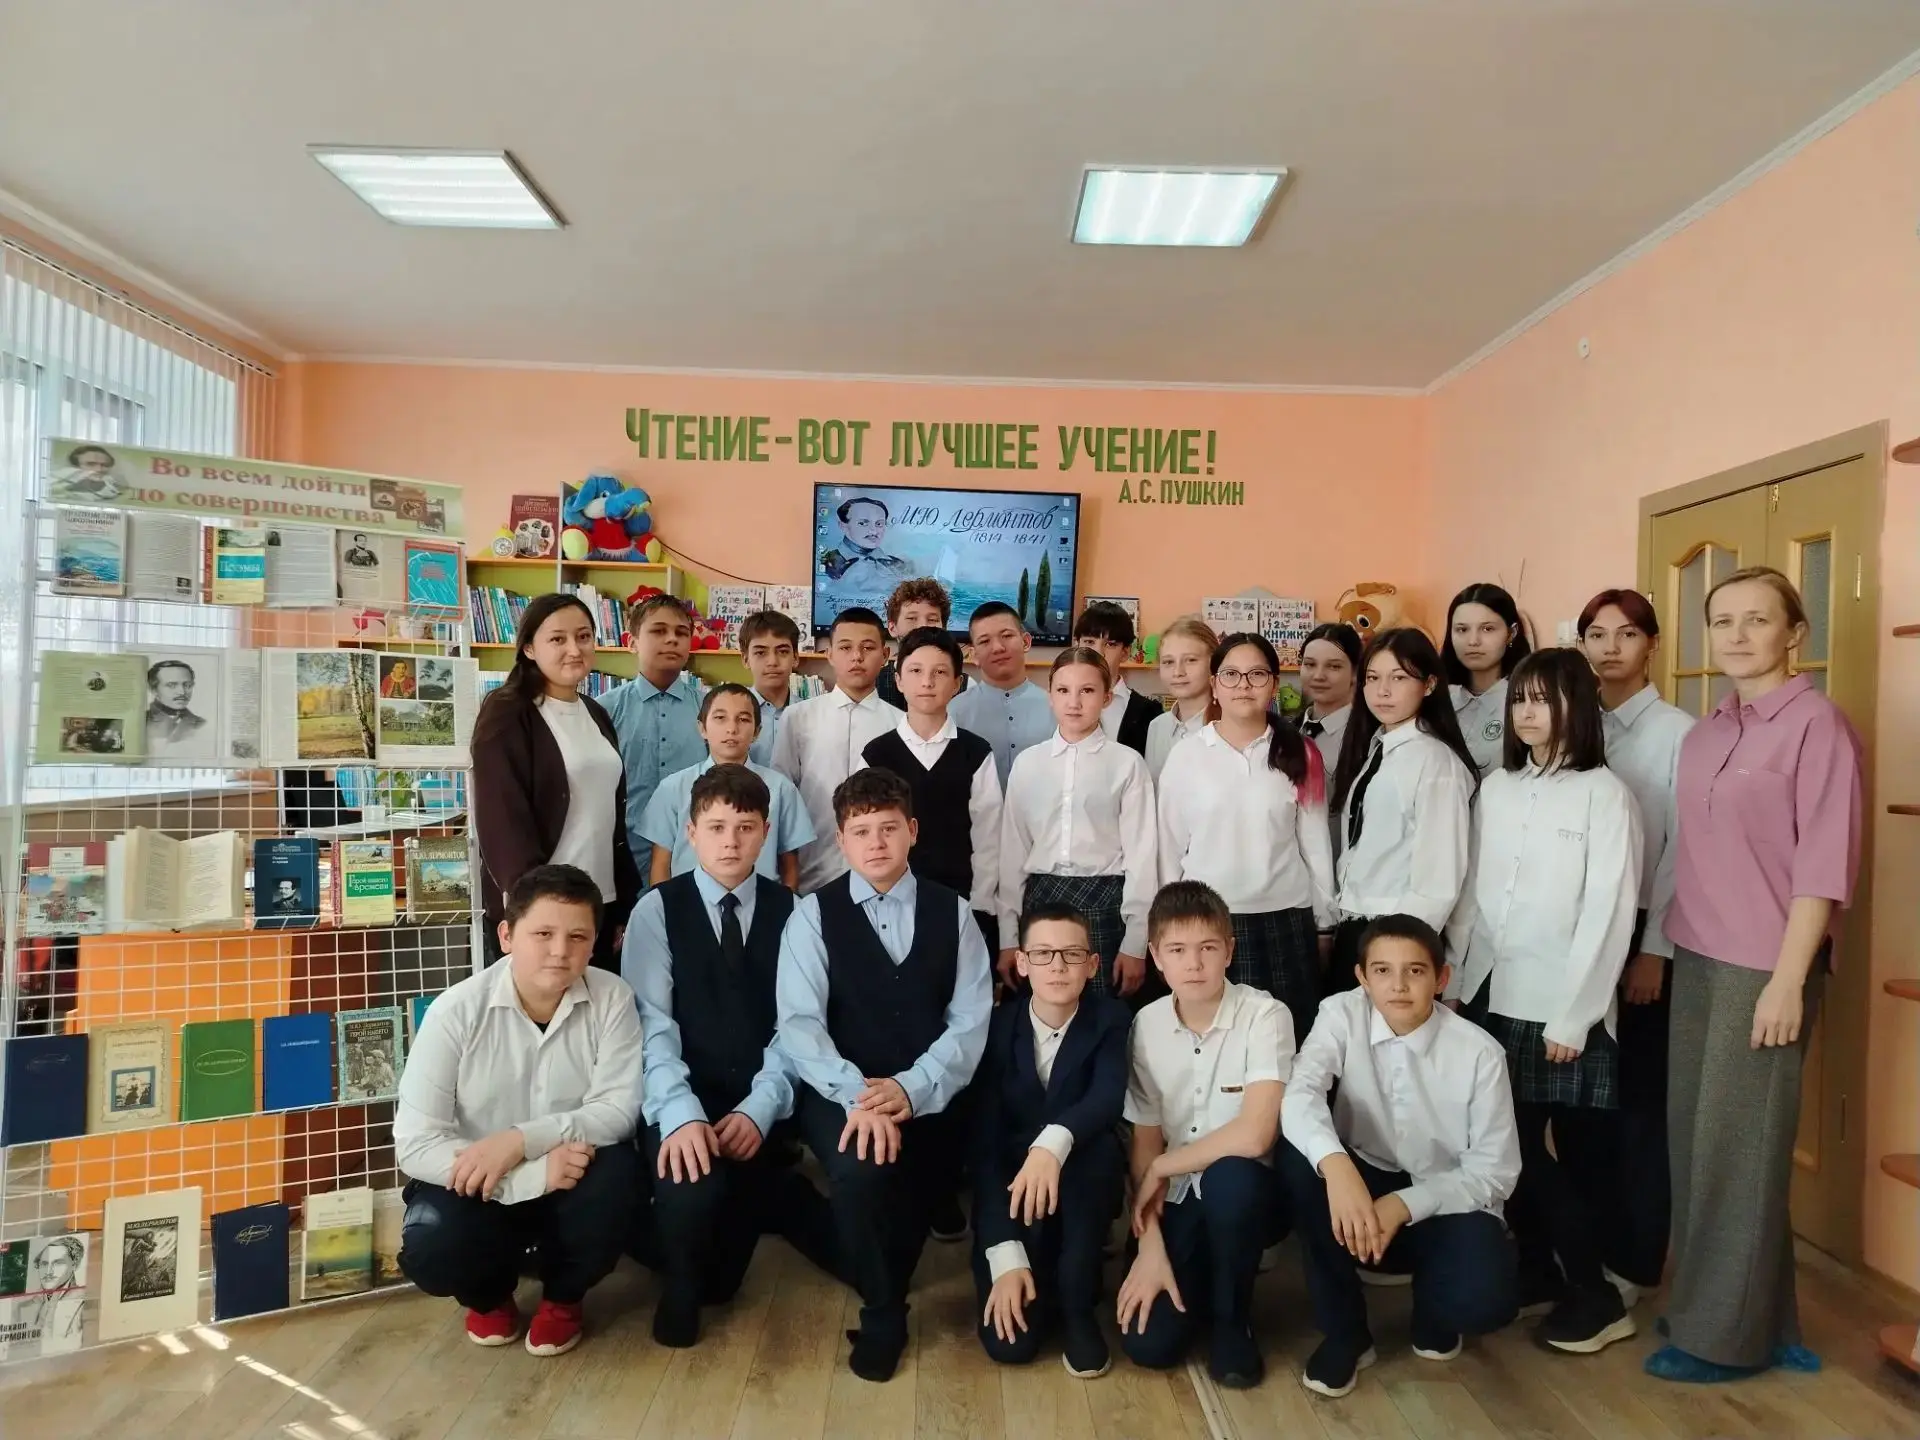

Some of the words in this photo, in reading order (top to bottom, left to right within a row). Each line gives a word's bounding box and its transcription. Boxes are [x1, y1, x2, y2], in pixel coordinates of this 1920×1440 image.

[889, 421, 1039, 469] ЛУЧШЕЕ
[1058, 425, 1216, 475] УЧЕНИЕ!
[151, 456, 190, 478] Во
[202, 466, 272, 486] всем
[281, 475, 367, 497] дойти
[128, 486, 165, 503] до
[175, 491, 385, 525] совершенства
